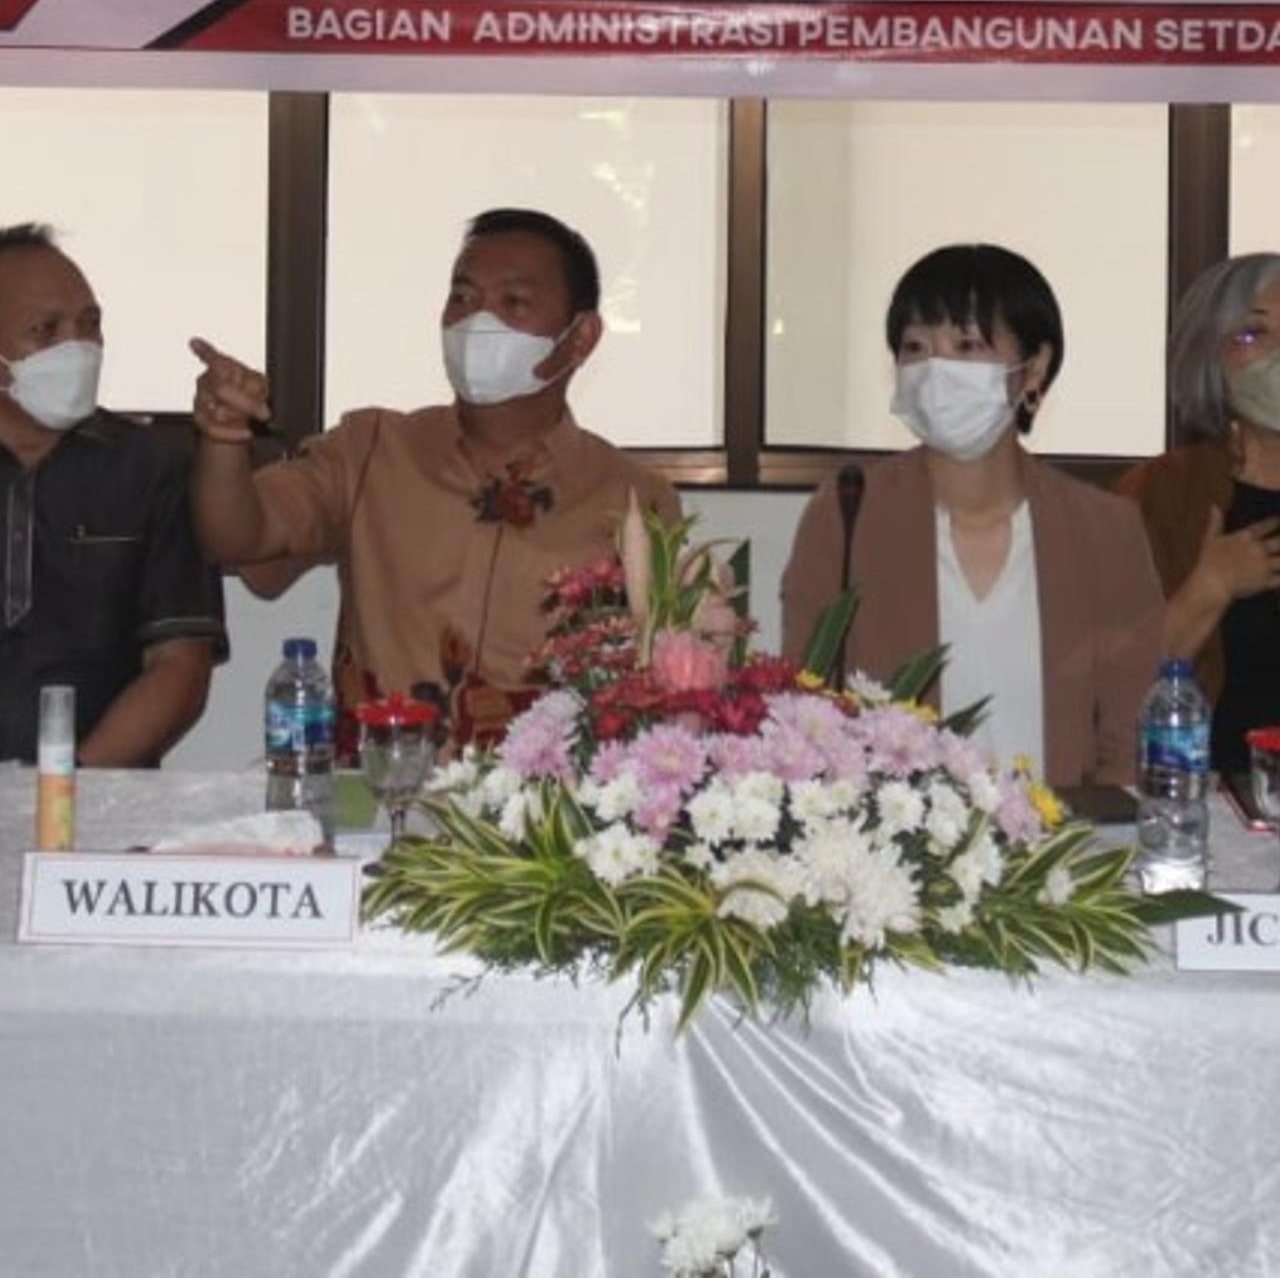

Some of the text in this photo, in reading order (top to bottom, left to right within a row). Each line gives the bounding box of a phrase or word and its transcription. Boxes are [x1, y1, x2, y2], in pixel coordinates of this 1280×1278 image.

[287, 7, 451, 43] BAGIAN
[473, 11, 786, 48] ADMINISTRASI
[798, 14, 1145, 52] PEMBANGUNAN
[63, 879, 324, 920] WALIKOTA
